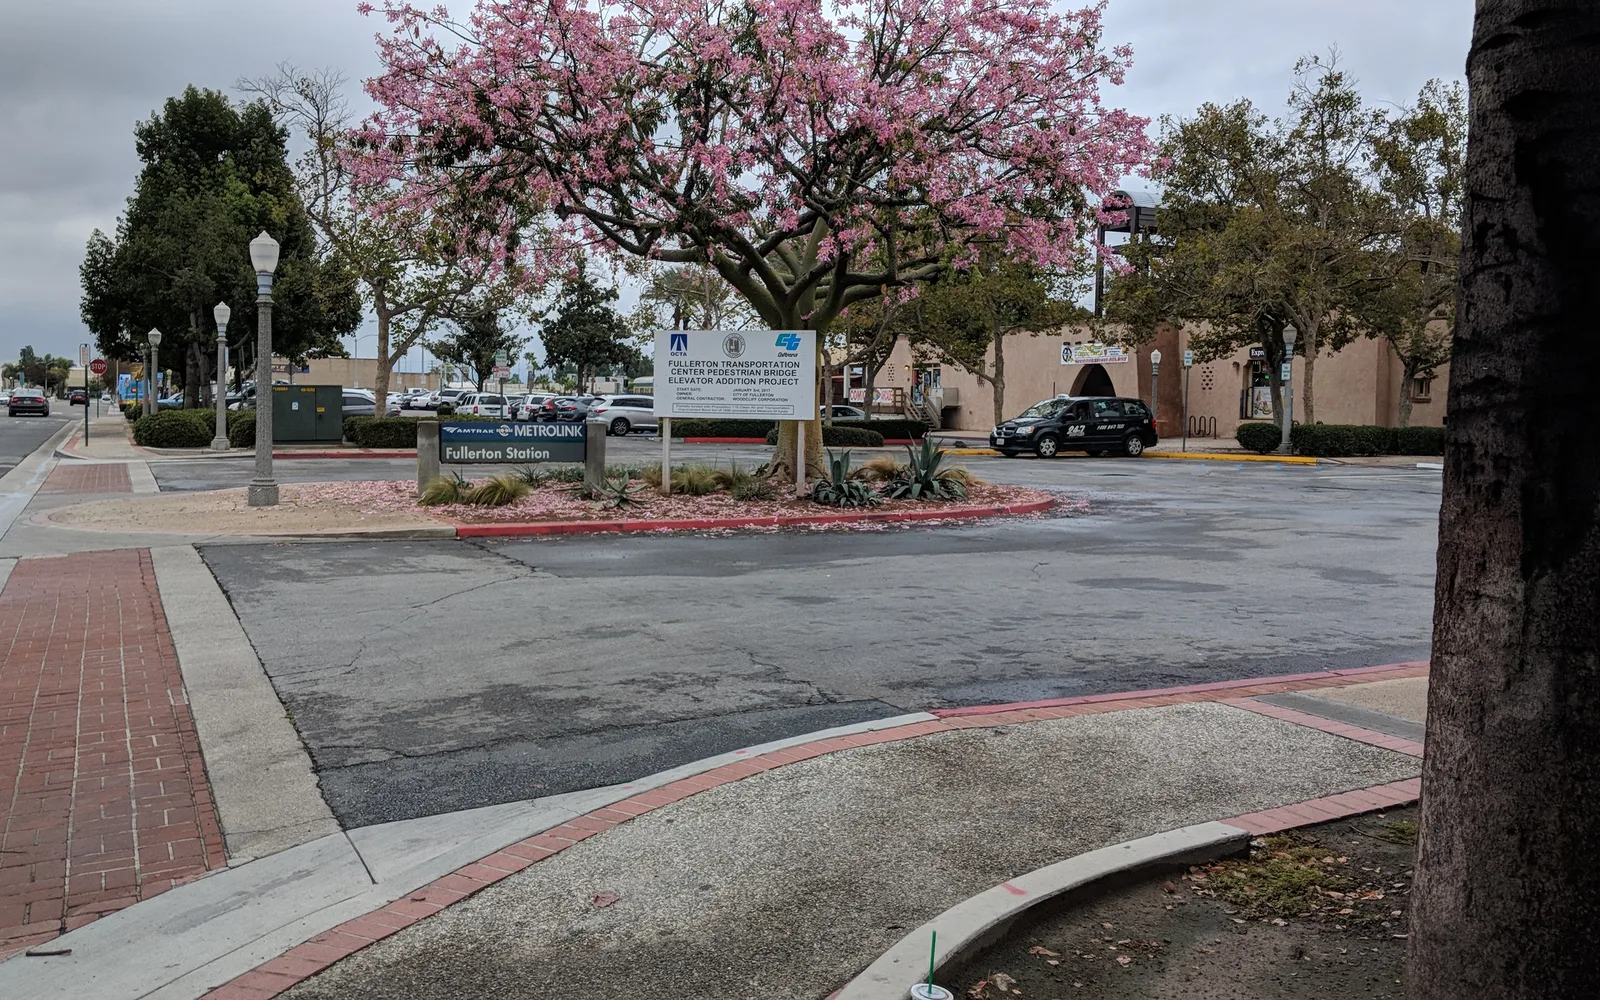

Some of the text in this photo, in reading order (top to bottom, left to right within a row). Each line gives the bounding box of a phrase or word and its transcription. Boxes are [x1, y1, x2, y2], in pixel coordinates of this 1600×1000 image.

[514, 424, 583, 437] METROLINK
[446, 446, 550, 460] Fullerton Station
